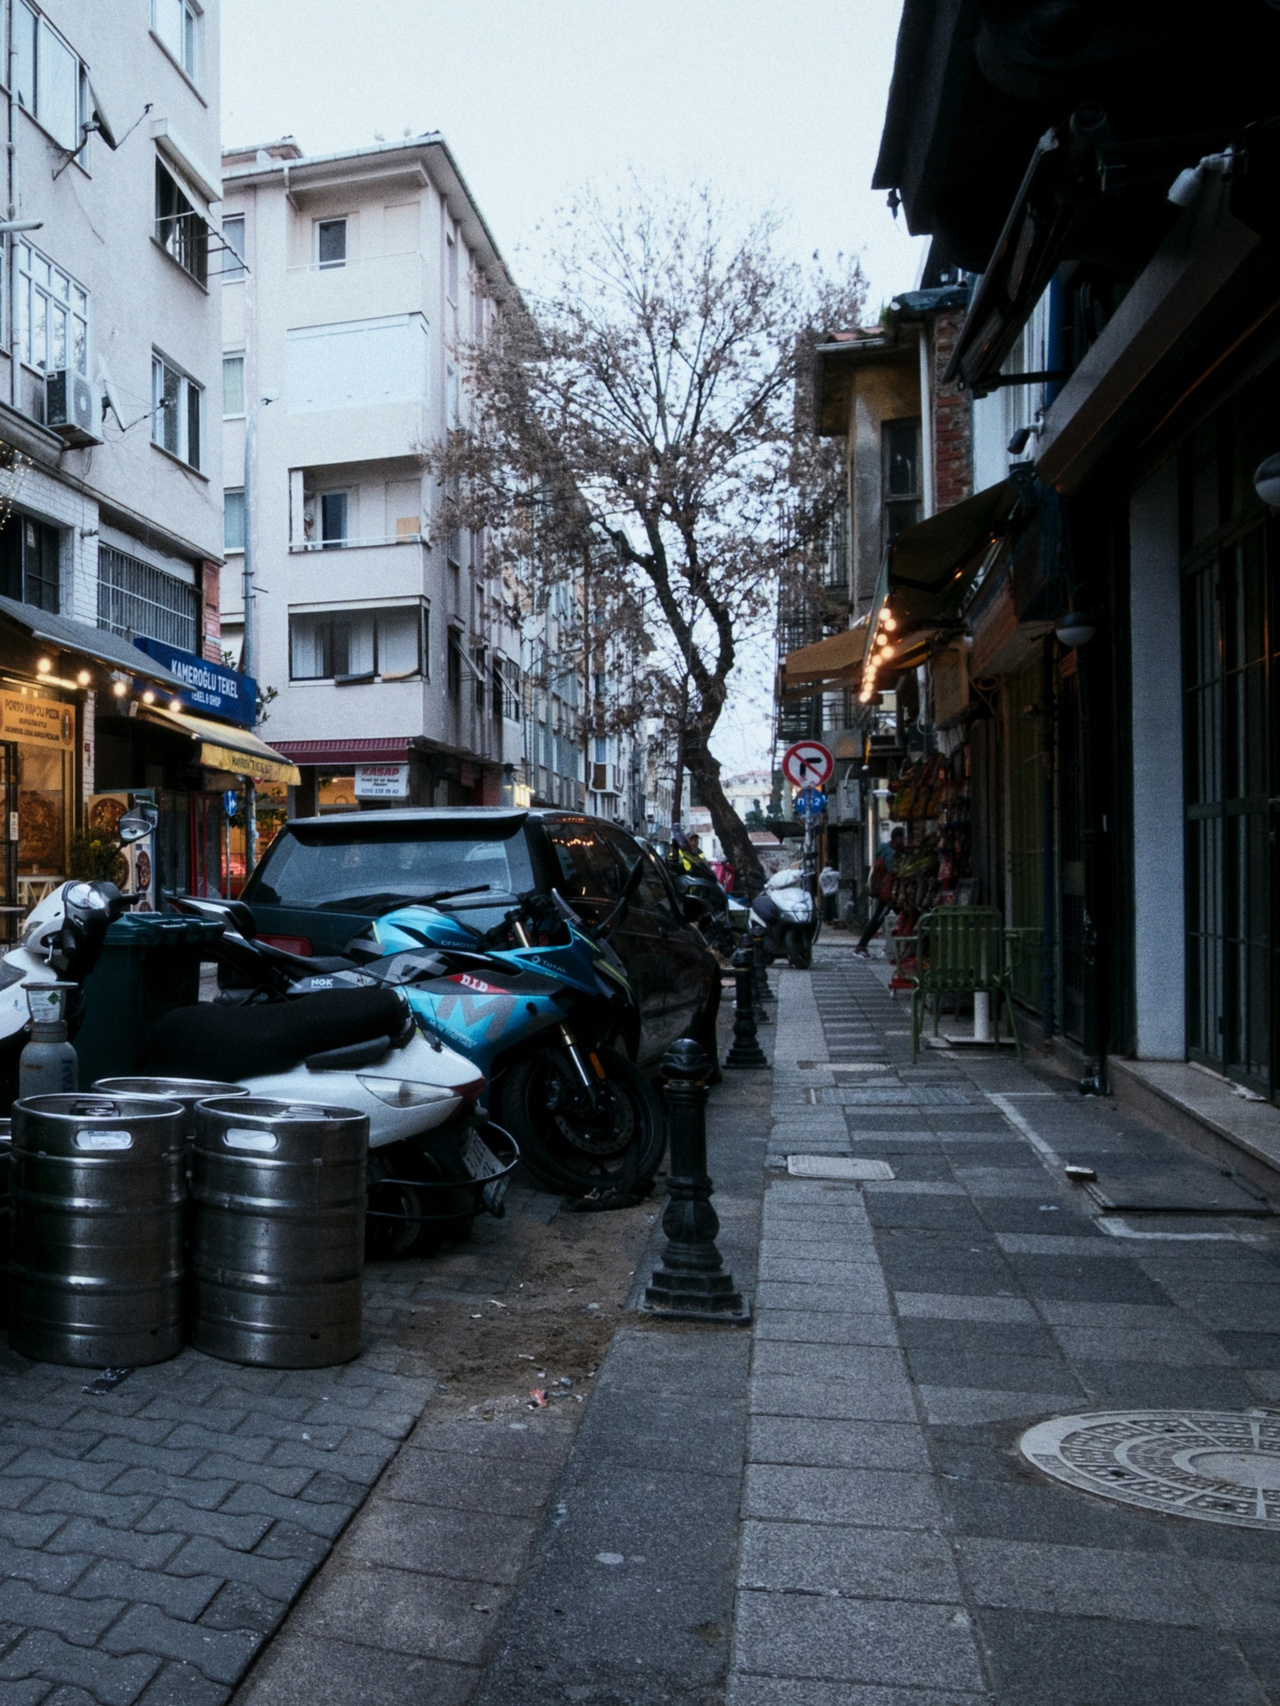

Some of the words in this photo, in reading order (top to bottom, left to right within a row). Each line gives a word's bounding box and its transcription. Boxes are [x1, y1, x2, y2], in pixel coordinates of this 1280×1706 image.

[171, 659, 217, 692] KAMEROĞLU
[217, 675, 239, 700] TEKEL
[4, 699, 24, 714] PORTO
[24, 703, 45, 718] NAPOLI
[45, 707, 60, 721] PIZZA
[362, 766, 400, 777] KASAP
[441, 940, 477, 950] CFMOTO
[542, 959, 568, 974] TOTAL
[311, 978, 334, 986] NGK
